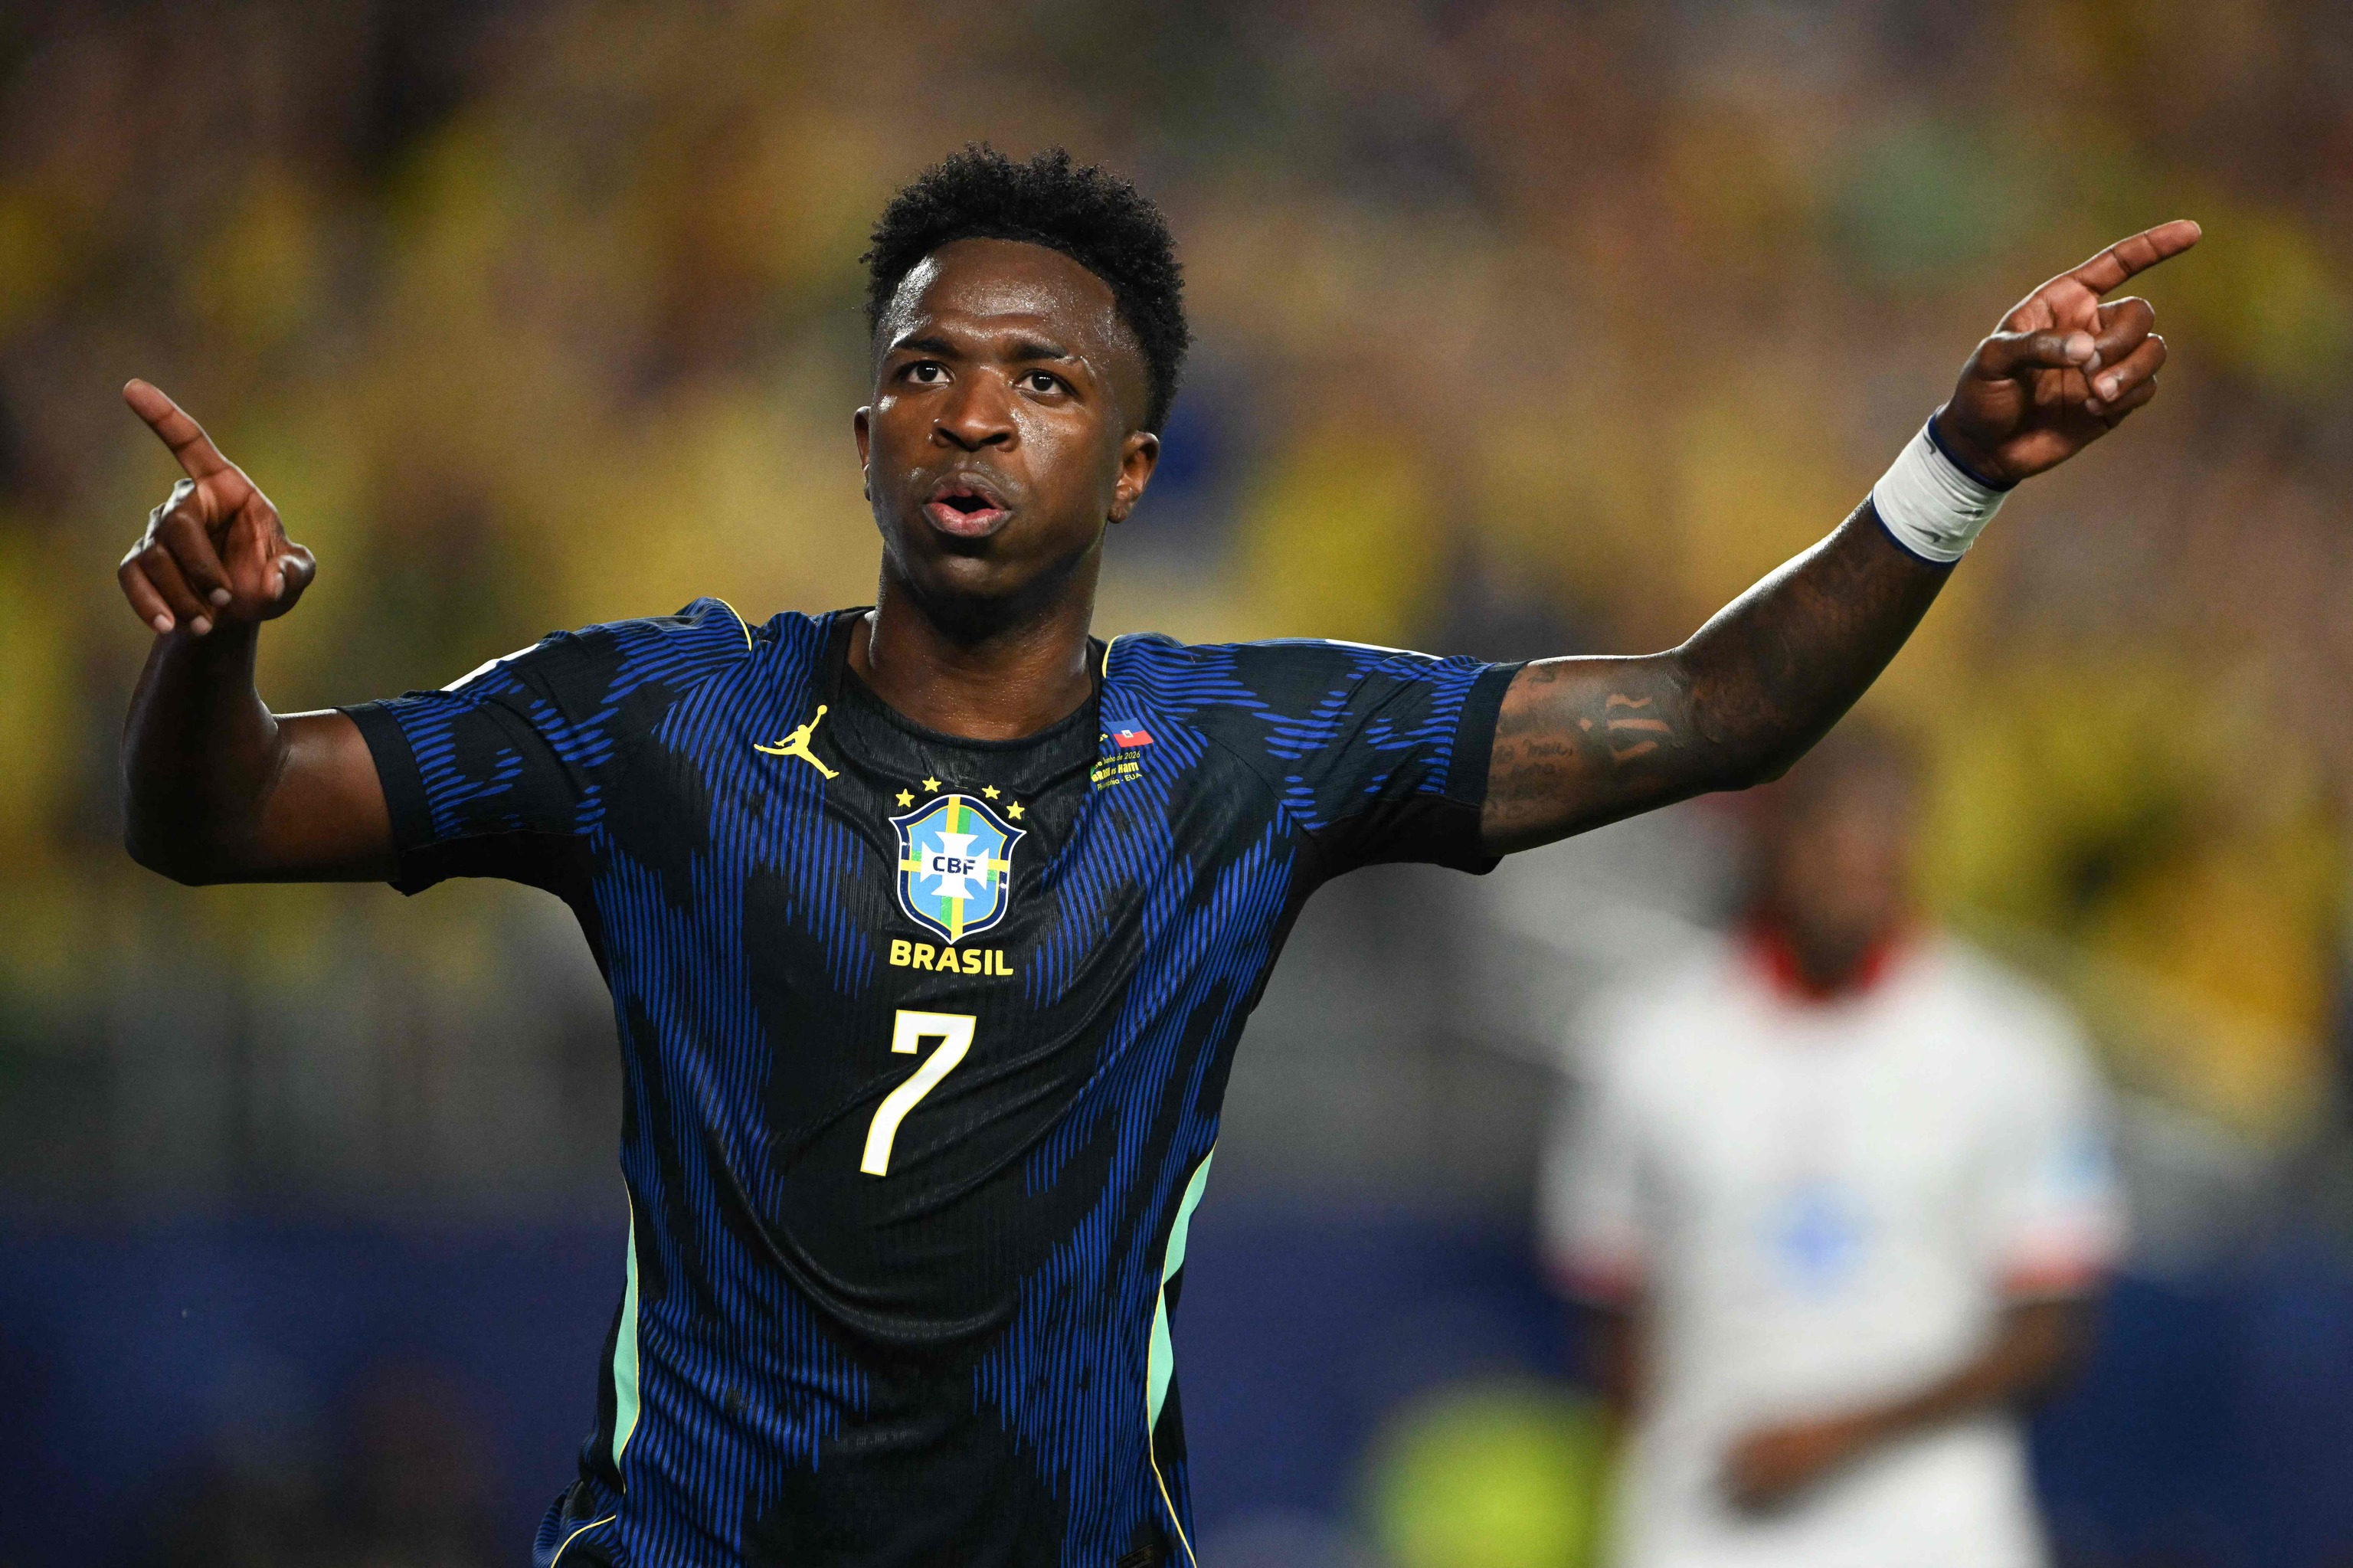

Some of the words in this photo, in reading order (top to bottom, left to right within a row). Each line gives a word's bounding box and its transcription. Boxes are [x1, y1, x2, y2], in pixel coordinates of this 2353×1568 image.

[1116, 753, 1124, 761] de
[1124, 751, 1141, 760] 2026
[1124, 772, 1143, 782] EUA
[933, 856, 976, 875] CBF
[889, 939, 1013, 976] BRASIL
[860, 1009, 977, 1177] 7
